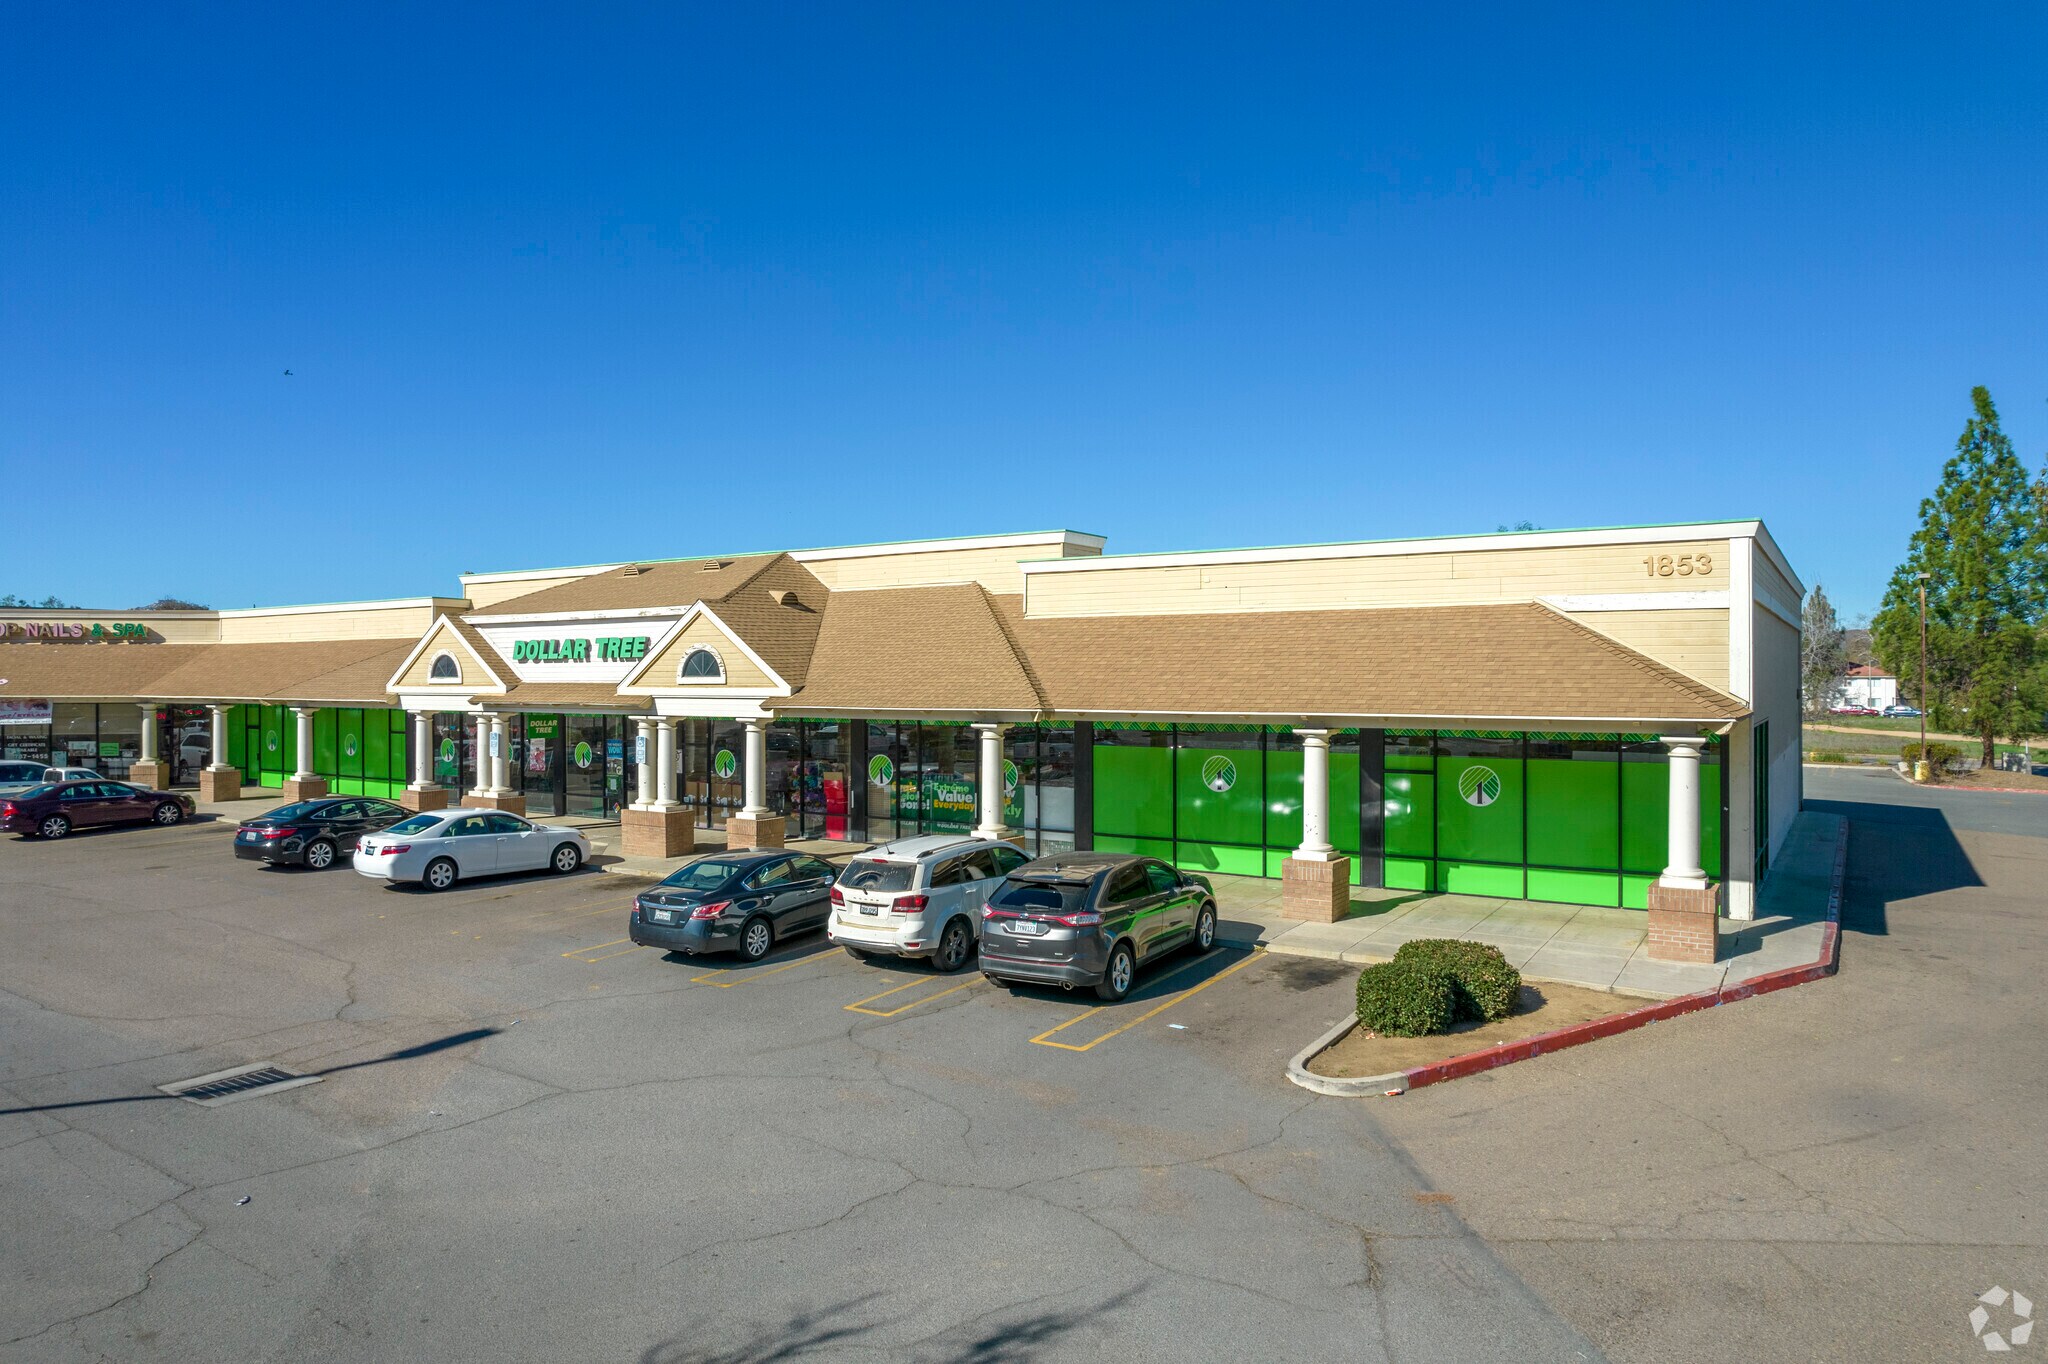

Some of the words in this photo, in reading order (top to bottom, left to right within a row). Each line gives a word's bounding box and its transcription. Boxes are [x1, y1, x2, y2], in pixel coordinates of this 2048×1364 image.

[1643, 553, 1713, 577] 1853
[26, 623, 83, 637] NAILS
[91, 623, 104, 637] &
[113, 623, 147, 637] SPA
[513, 638, 587, 660] DOLLAR
[595, 636, 647, 659] TREE
[933, 782, 969, 792] Extreme
[937, 789, 973, 803] Value
[933, 800, 975, 812] Everyday
